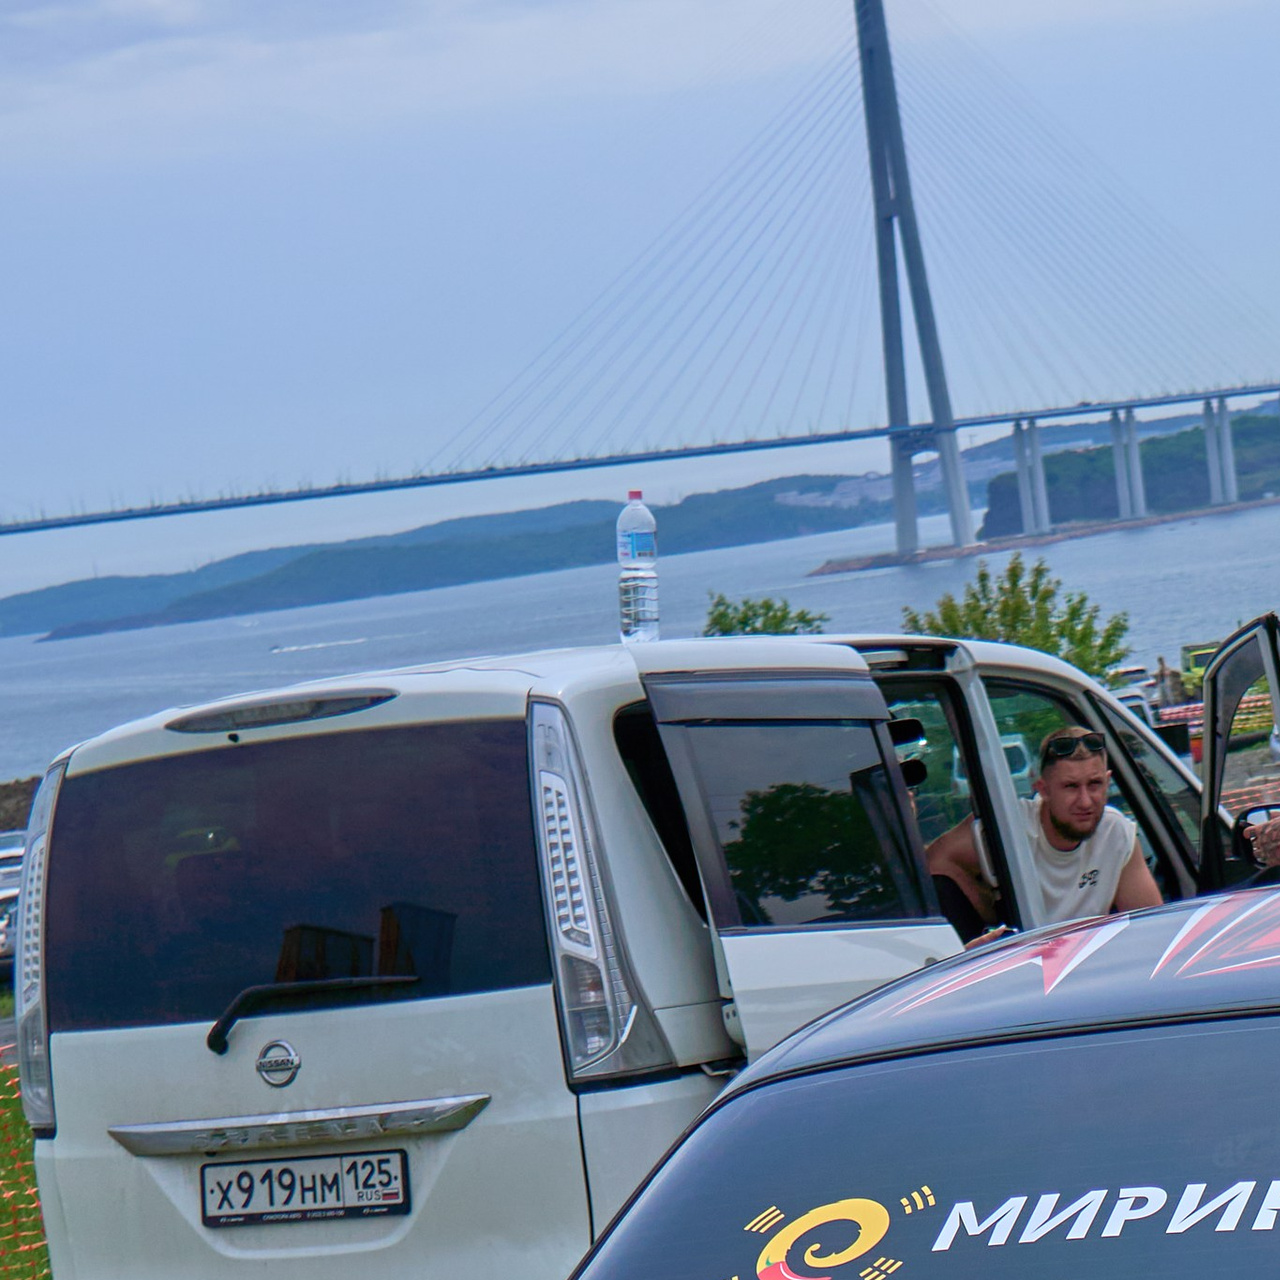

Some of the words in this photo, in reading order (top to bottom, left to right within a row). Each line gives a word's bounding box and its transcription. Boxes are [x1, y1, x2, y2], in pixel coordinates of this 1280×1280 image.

[258, 1057, 295, 1070] NISSAN
[217, 1169, 341, 1210] Х919НМ
[346, 1159, 392, 1191] 125
[357, 1189, 382, 1202] RUS
